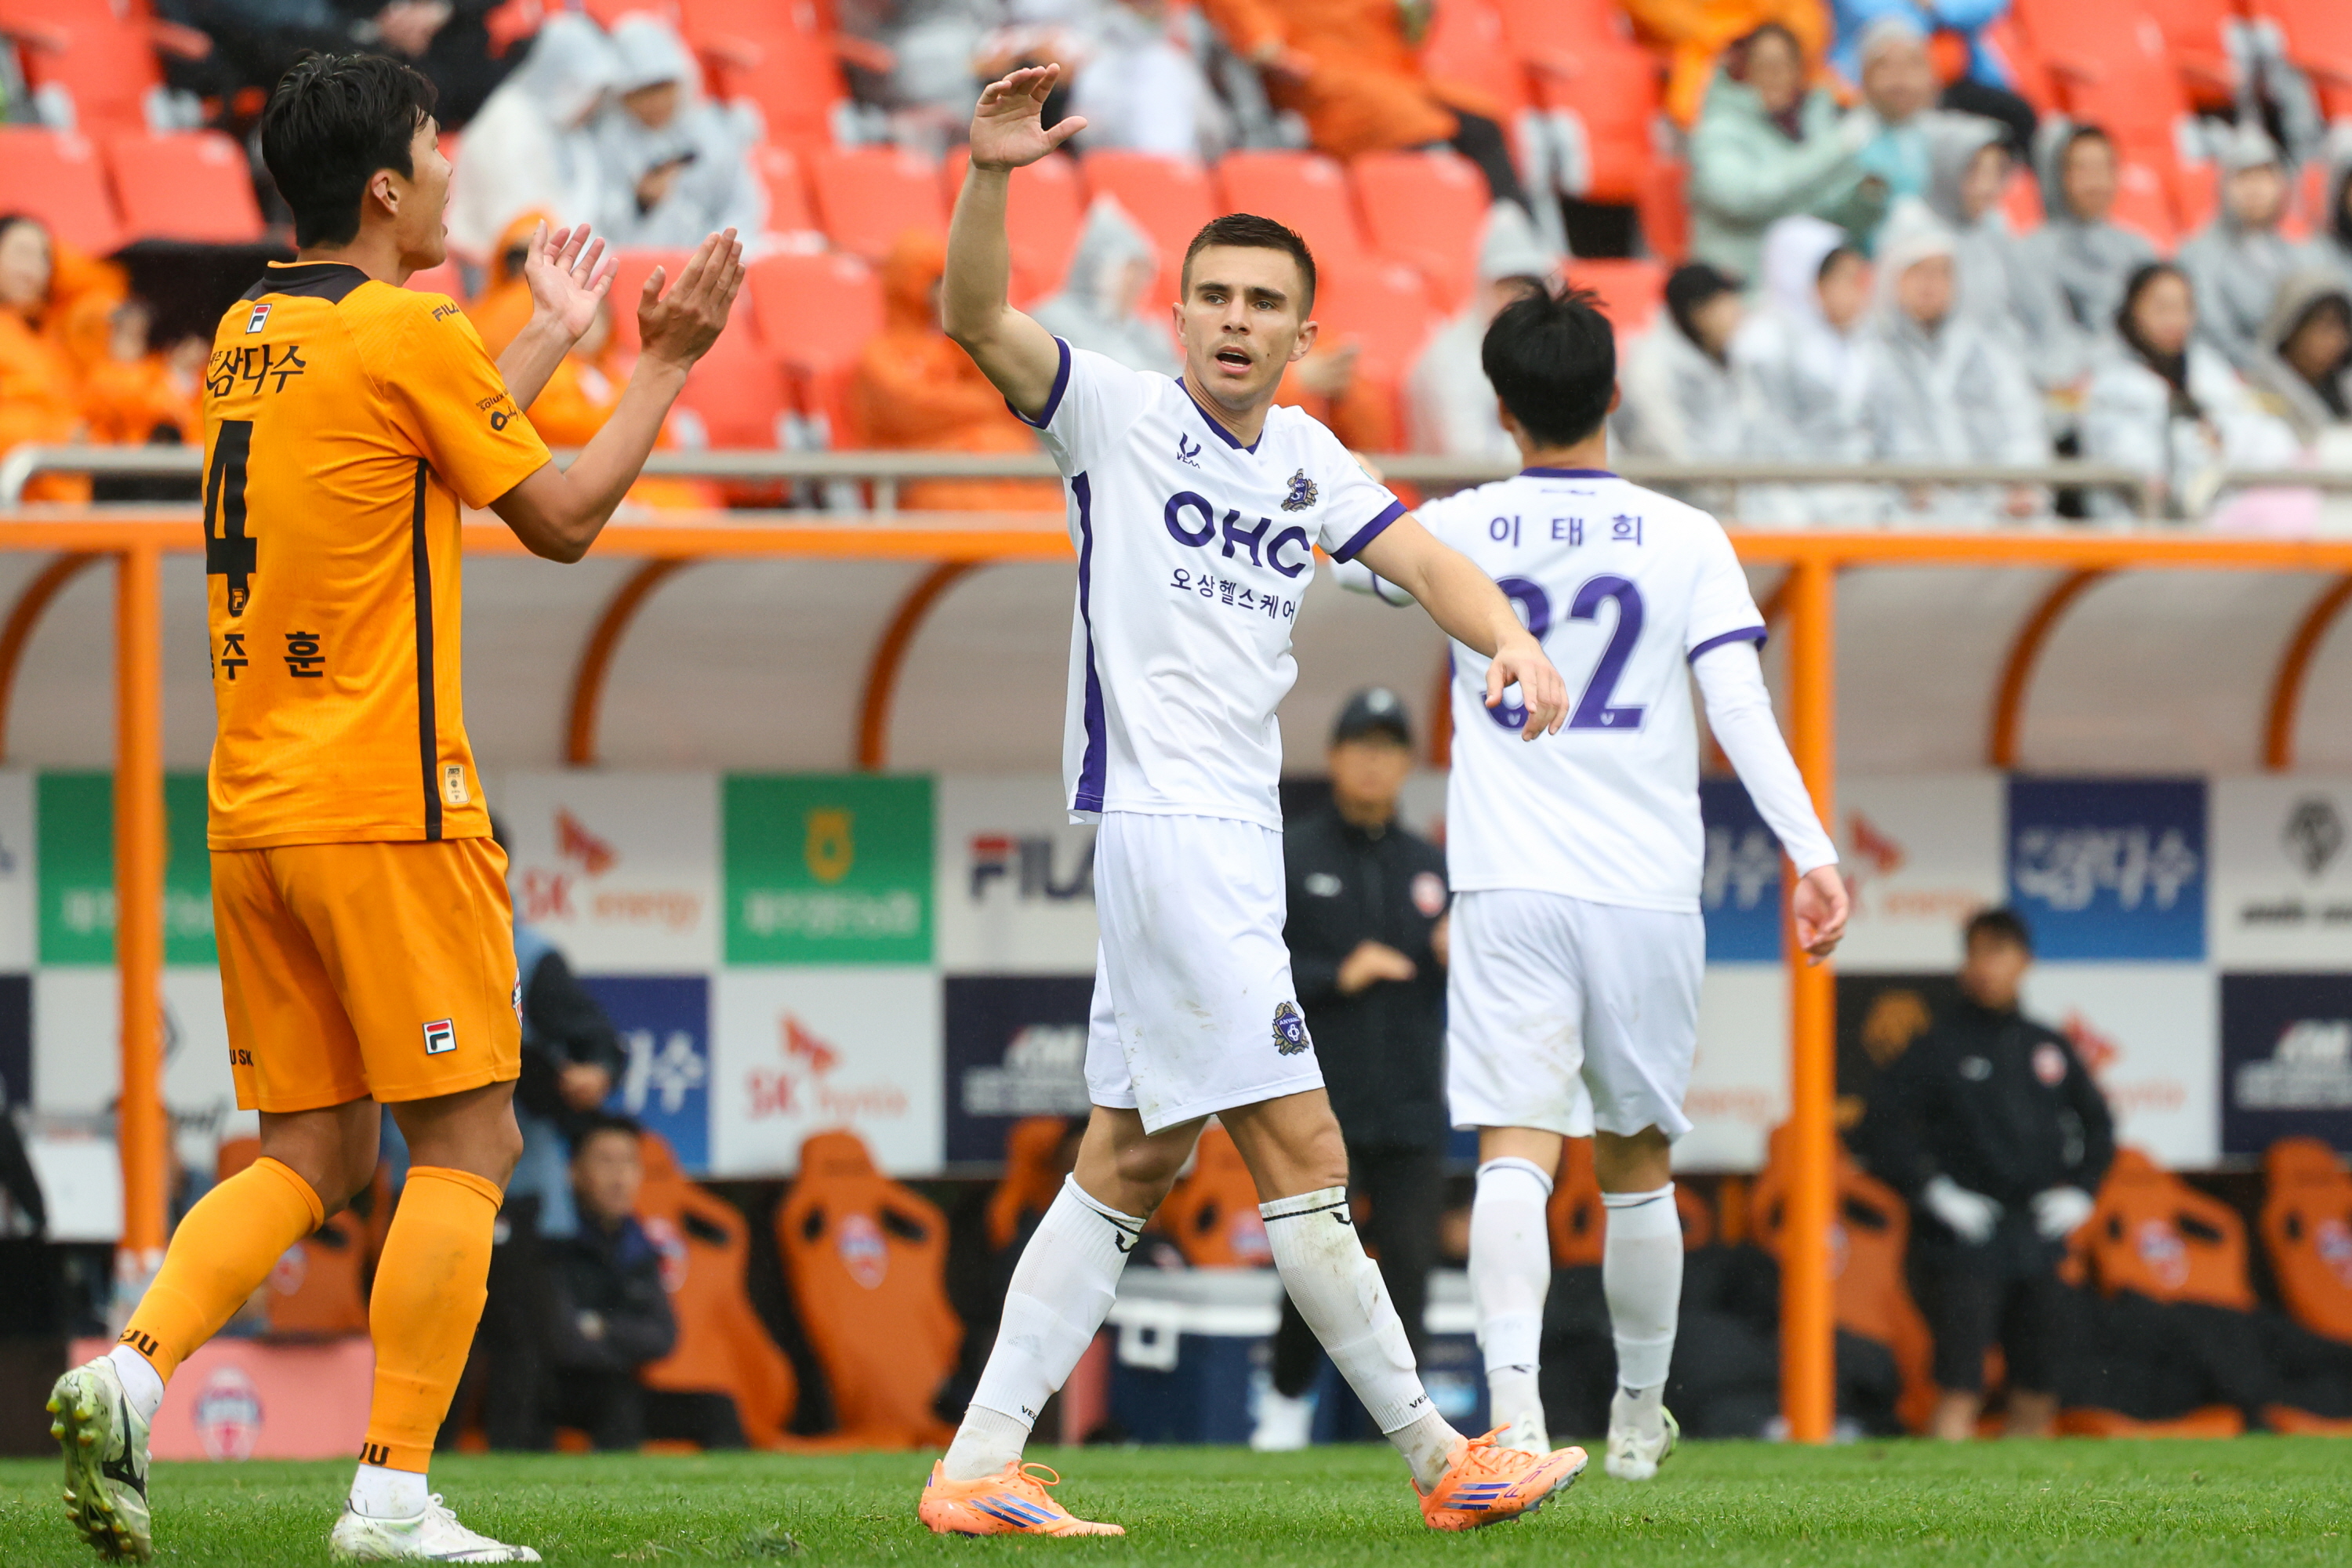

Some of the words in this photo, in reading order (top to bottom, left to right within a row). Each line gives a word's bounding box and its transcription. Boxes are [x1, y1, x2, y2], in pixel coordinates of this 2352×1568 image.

[432, 302, 460, 322] FILA
[205, 419, 257, 618] 4
[1164, 491, 1312, 579] OHC
[238, 1048, 255, 1067] SK
